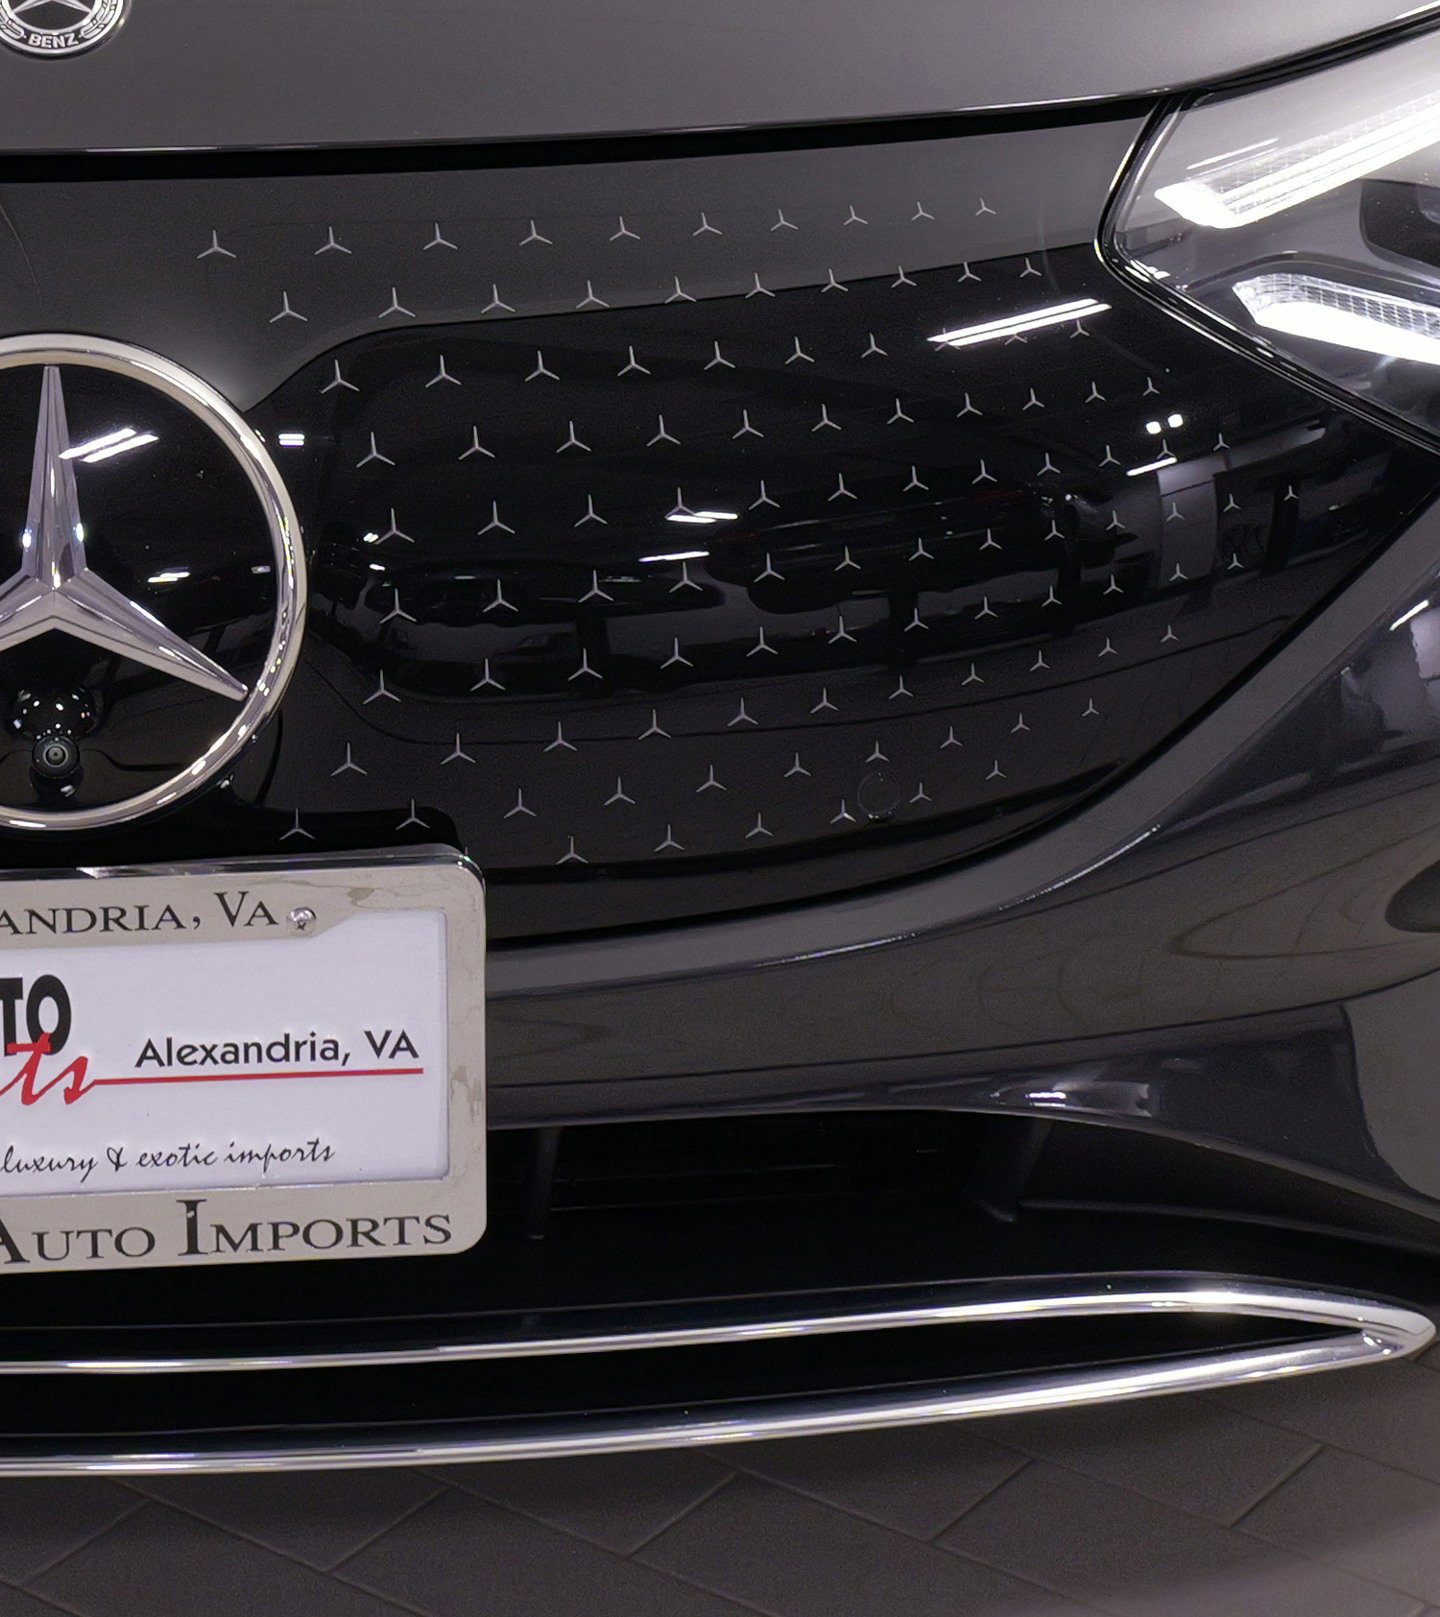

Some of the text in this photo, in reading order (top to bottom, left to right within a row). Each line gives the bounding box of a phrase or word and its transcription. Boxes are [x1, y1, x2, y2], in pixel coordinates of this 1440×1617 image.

[28, 32, 79, 48] BENZ
[135, 1029, 420, 1068] Alexandria, VA
[0, 1145, 99, 1183] luxury
[106, 1146, 128, 1172] &
[136, 1142, 218, 1169] exotic
[224, 1136, 336, 1173] imports
[176, 1199, 452, 1257] IMPORTS
